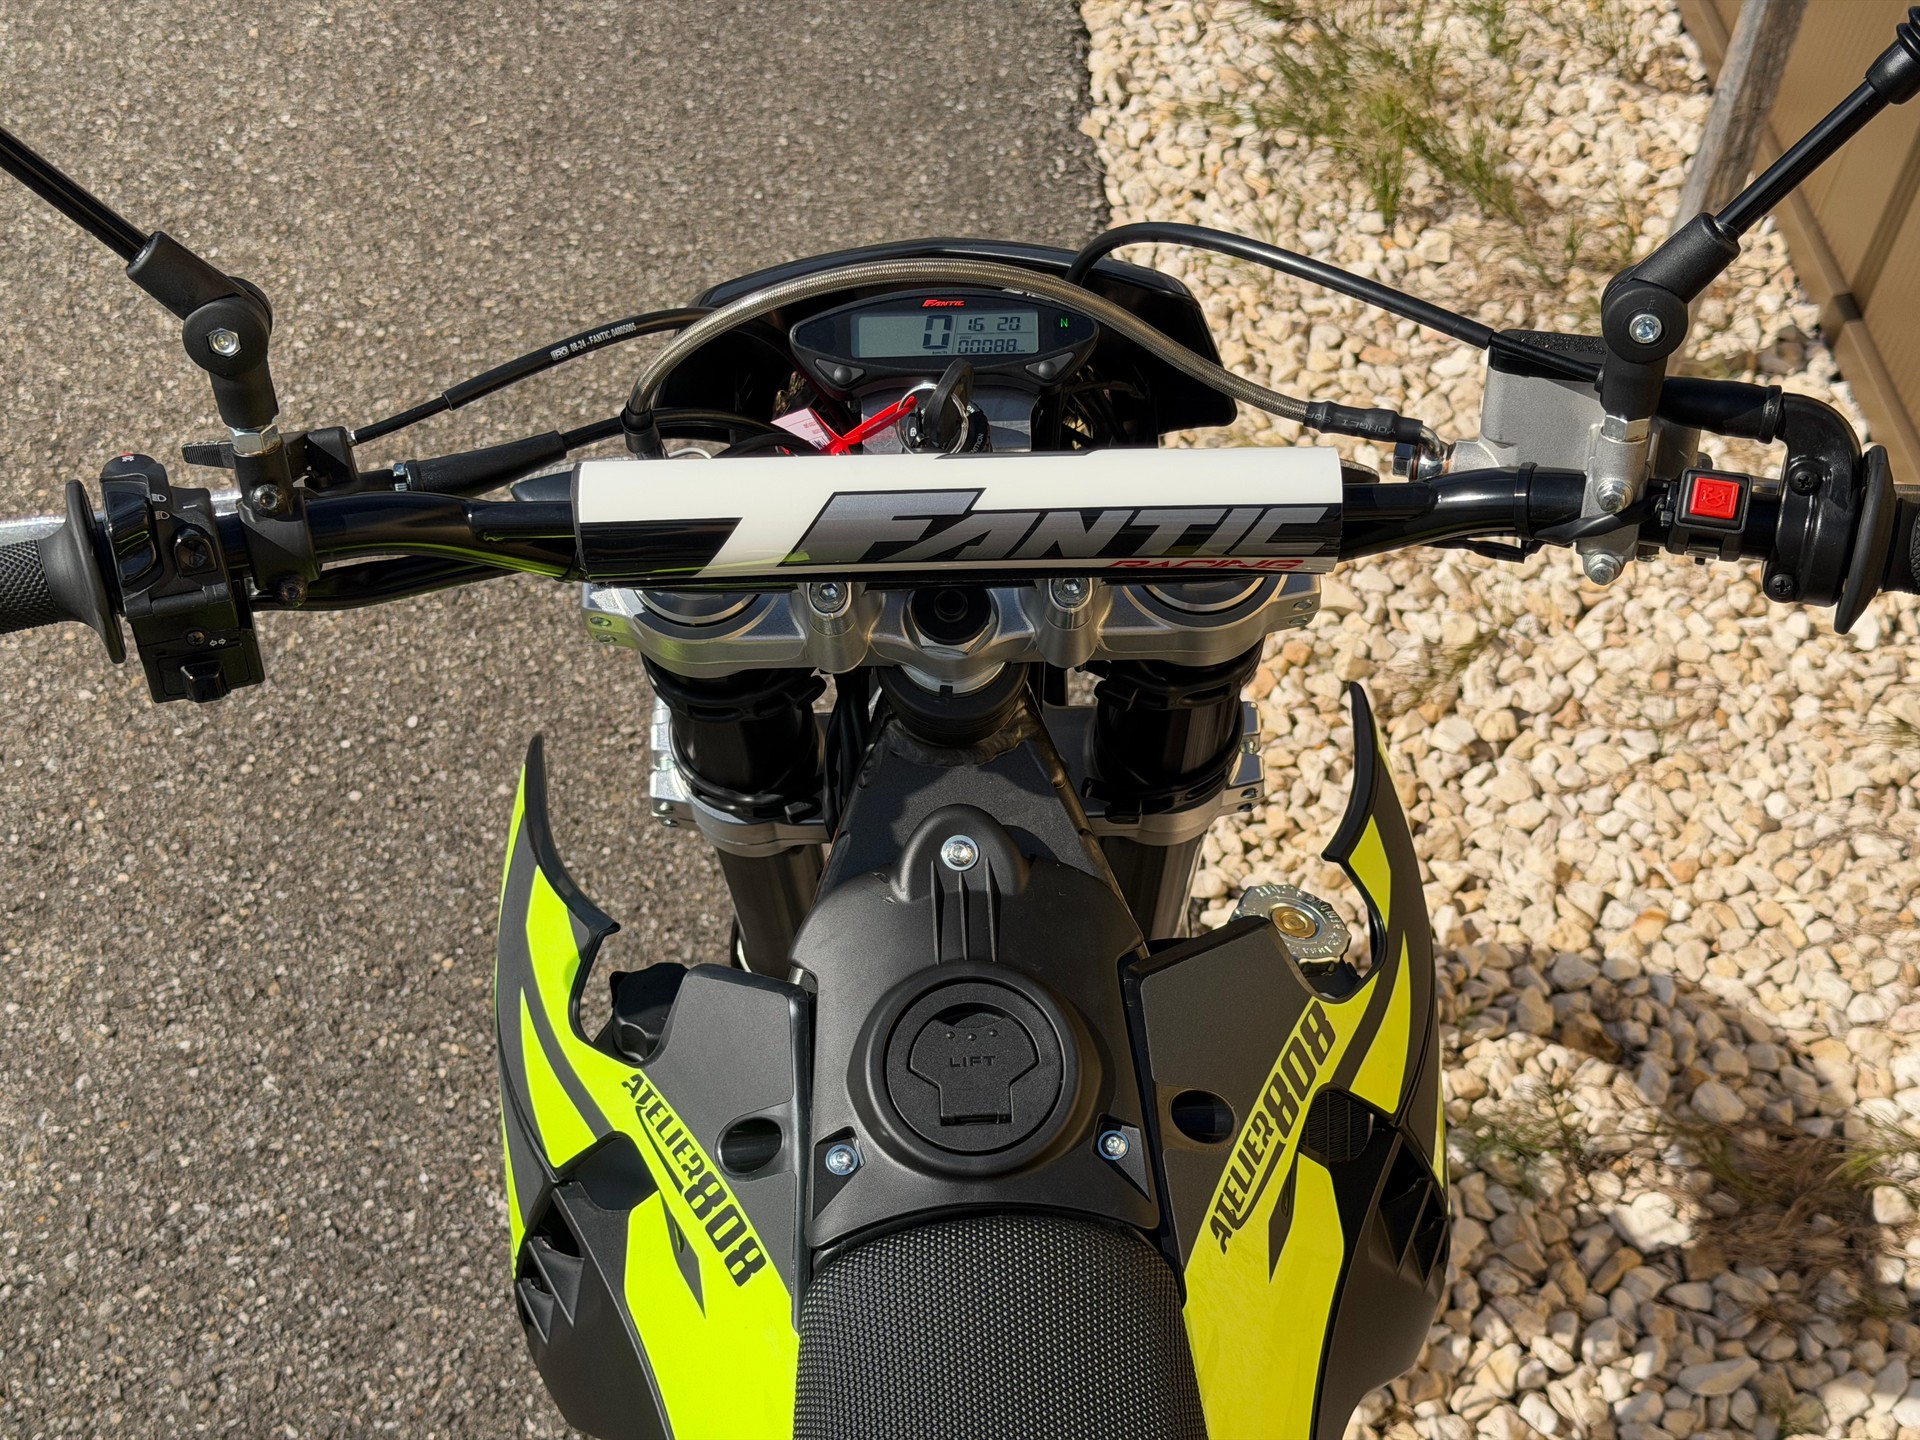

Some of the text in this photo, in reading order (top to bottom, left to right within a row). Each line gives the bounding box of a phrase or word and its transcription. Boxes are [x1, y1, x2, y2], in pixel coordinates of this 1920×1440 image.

[997, 317, 1020, 331] 20
[1060, 318, 1069, 328] N
[588, 330, 612, 345] FANTIC
[922, 315, 953, 350] 0
[958, 339, 1017, 353] 00088
[778, 488, 1328, 566] FANTIC
[950, 1055, 996, 1068] LIFT
